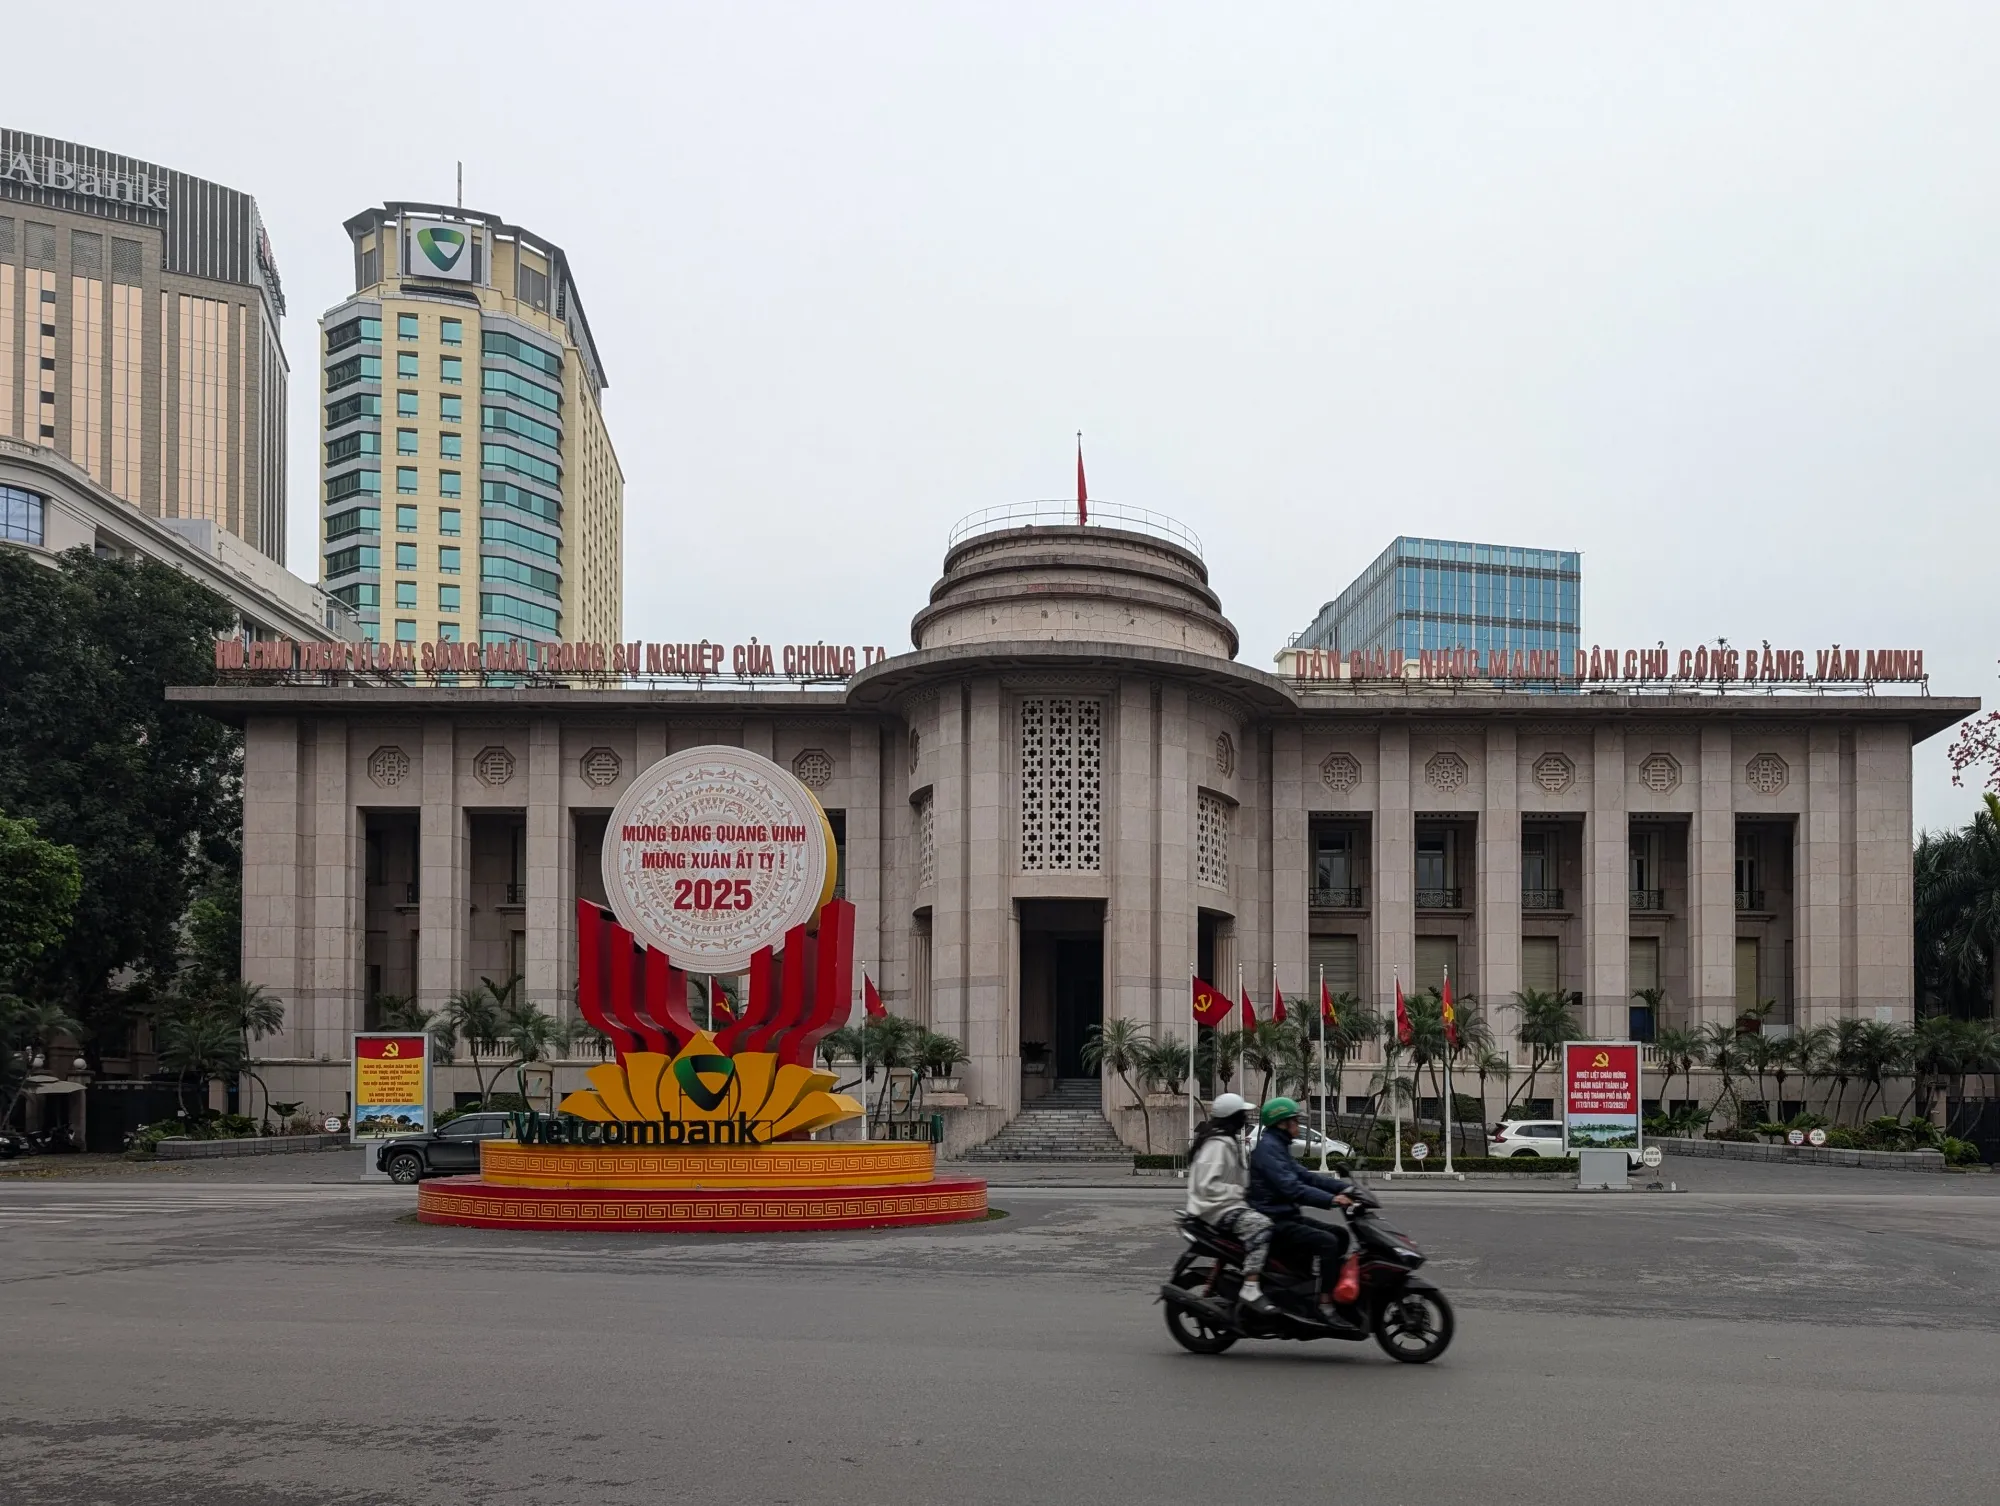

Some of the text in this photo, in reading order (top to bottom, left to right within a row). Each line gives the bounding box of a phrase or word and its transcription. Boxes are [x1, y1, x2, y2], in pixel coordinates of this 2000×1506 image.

[421, 635, 480, 671] SỐNG
[534, 642, 605, 671] TRONG
[613, 640, 642, 679] SỰ
[646, 639, 725, 680] NGHIỆP
[733, 636, 775, 674] CỦA
[783, 640, 856, 675] CHÚNG
[1296, 645, 1341, 679] DÂN
[1575, 645, 1618, 679] DÂN
[1679, 645, 1739, 679] CÔNG
[1816, 644, 1859, 679] VĂN
[716, 825, 767, 844] QUANG
[771, 825, 806, 842] VINH
[690, 849, 731, 869] XUÂN
[673, 879, 753, 910] 2025
[511, 1111, 762, 1145] Vietcombank
